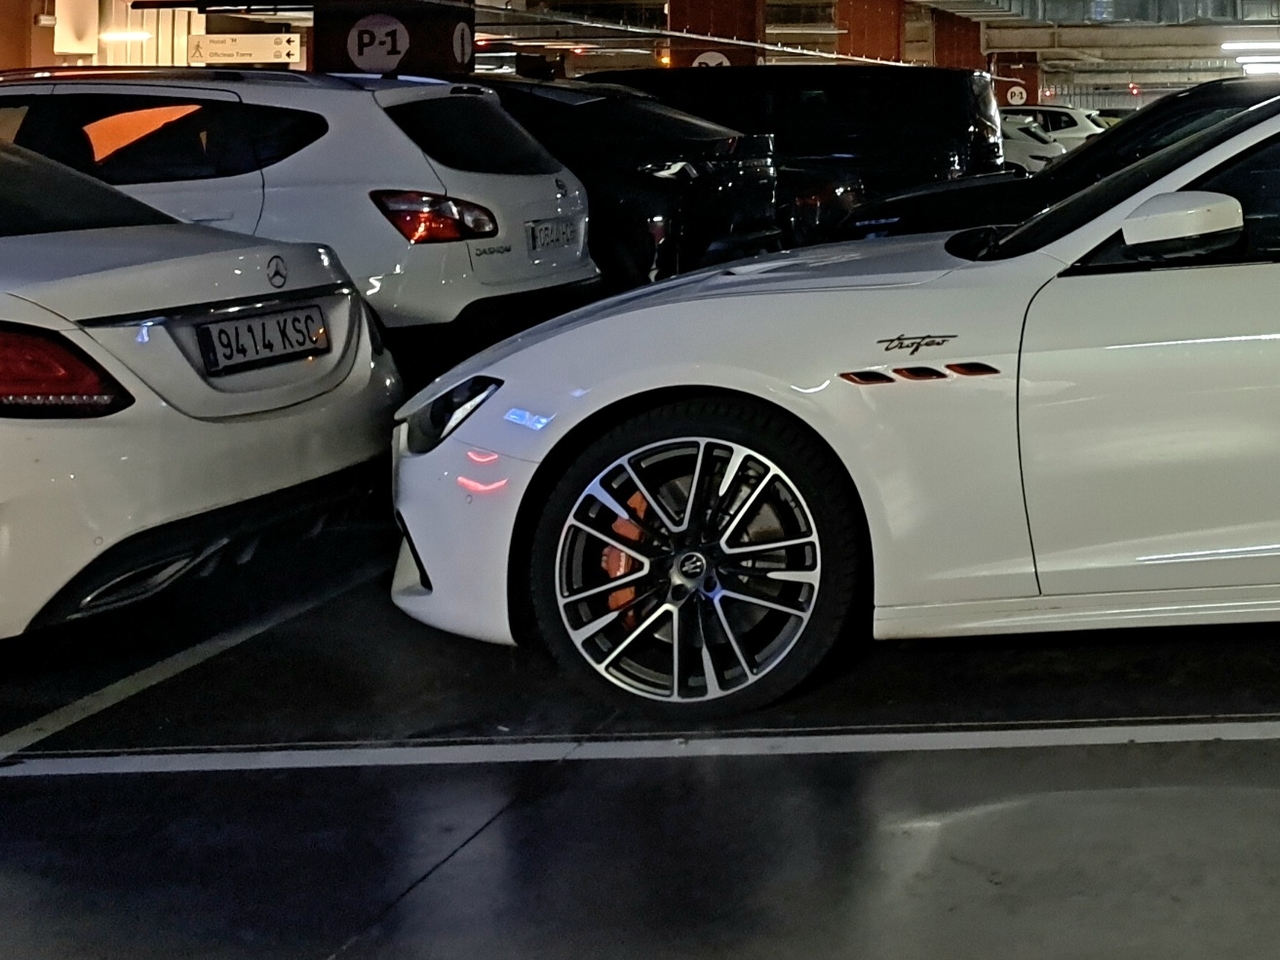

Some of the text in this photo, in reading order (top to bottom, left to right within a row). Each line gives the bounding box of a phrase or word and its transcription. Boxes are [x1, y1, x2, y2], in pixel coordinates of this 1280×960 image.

[357, 28, 402, 56] P-1
[1010, 91, 1024, 100] P-1
[217, 314, 319, 360] 9414 KSC
[876, 334, 958, 356] trofeo
